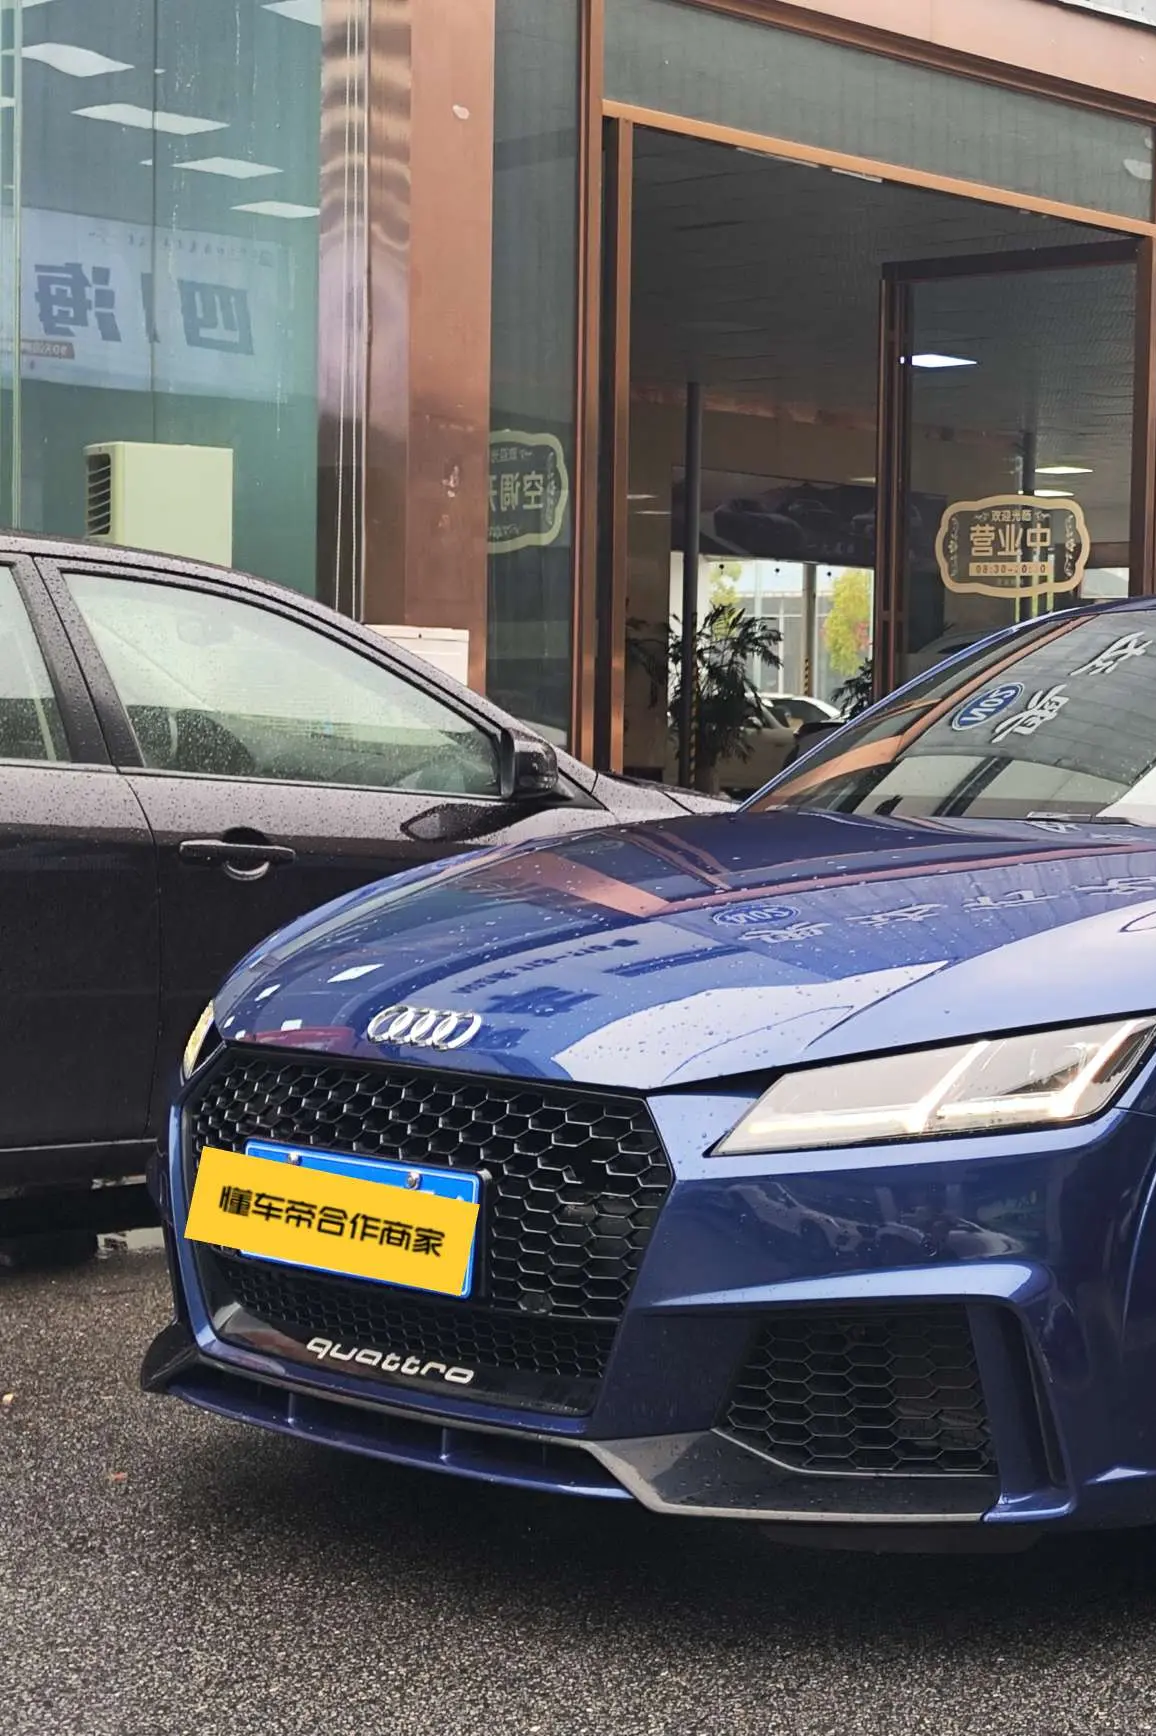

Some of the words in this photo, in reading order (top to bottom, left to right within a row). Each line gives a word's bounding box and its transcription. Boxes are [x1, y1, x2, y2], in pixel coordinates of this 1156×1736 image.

[970, 523, 1051, 558] 营业中
[306, 1336, 475, 1384] quattro
